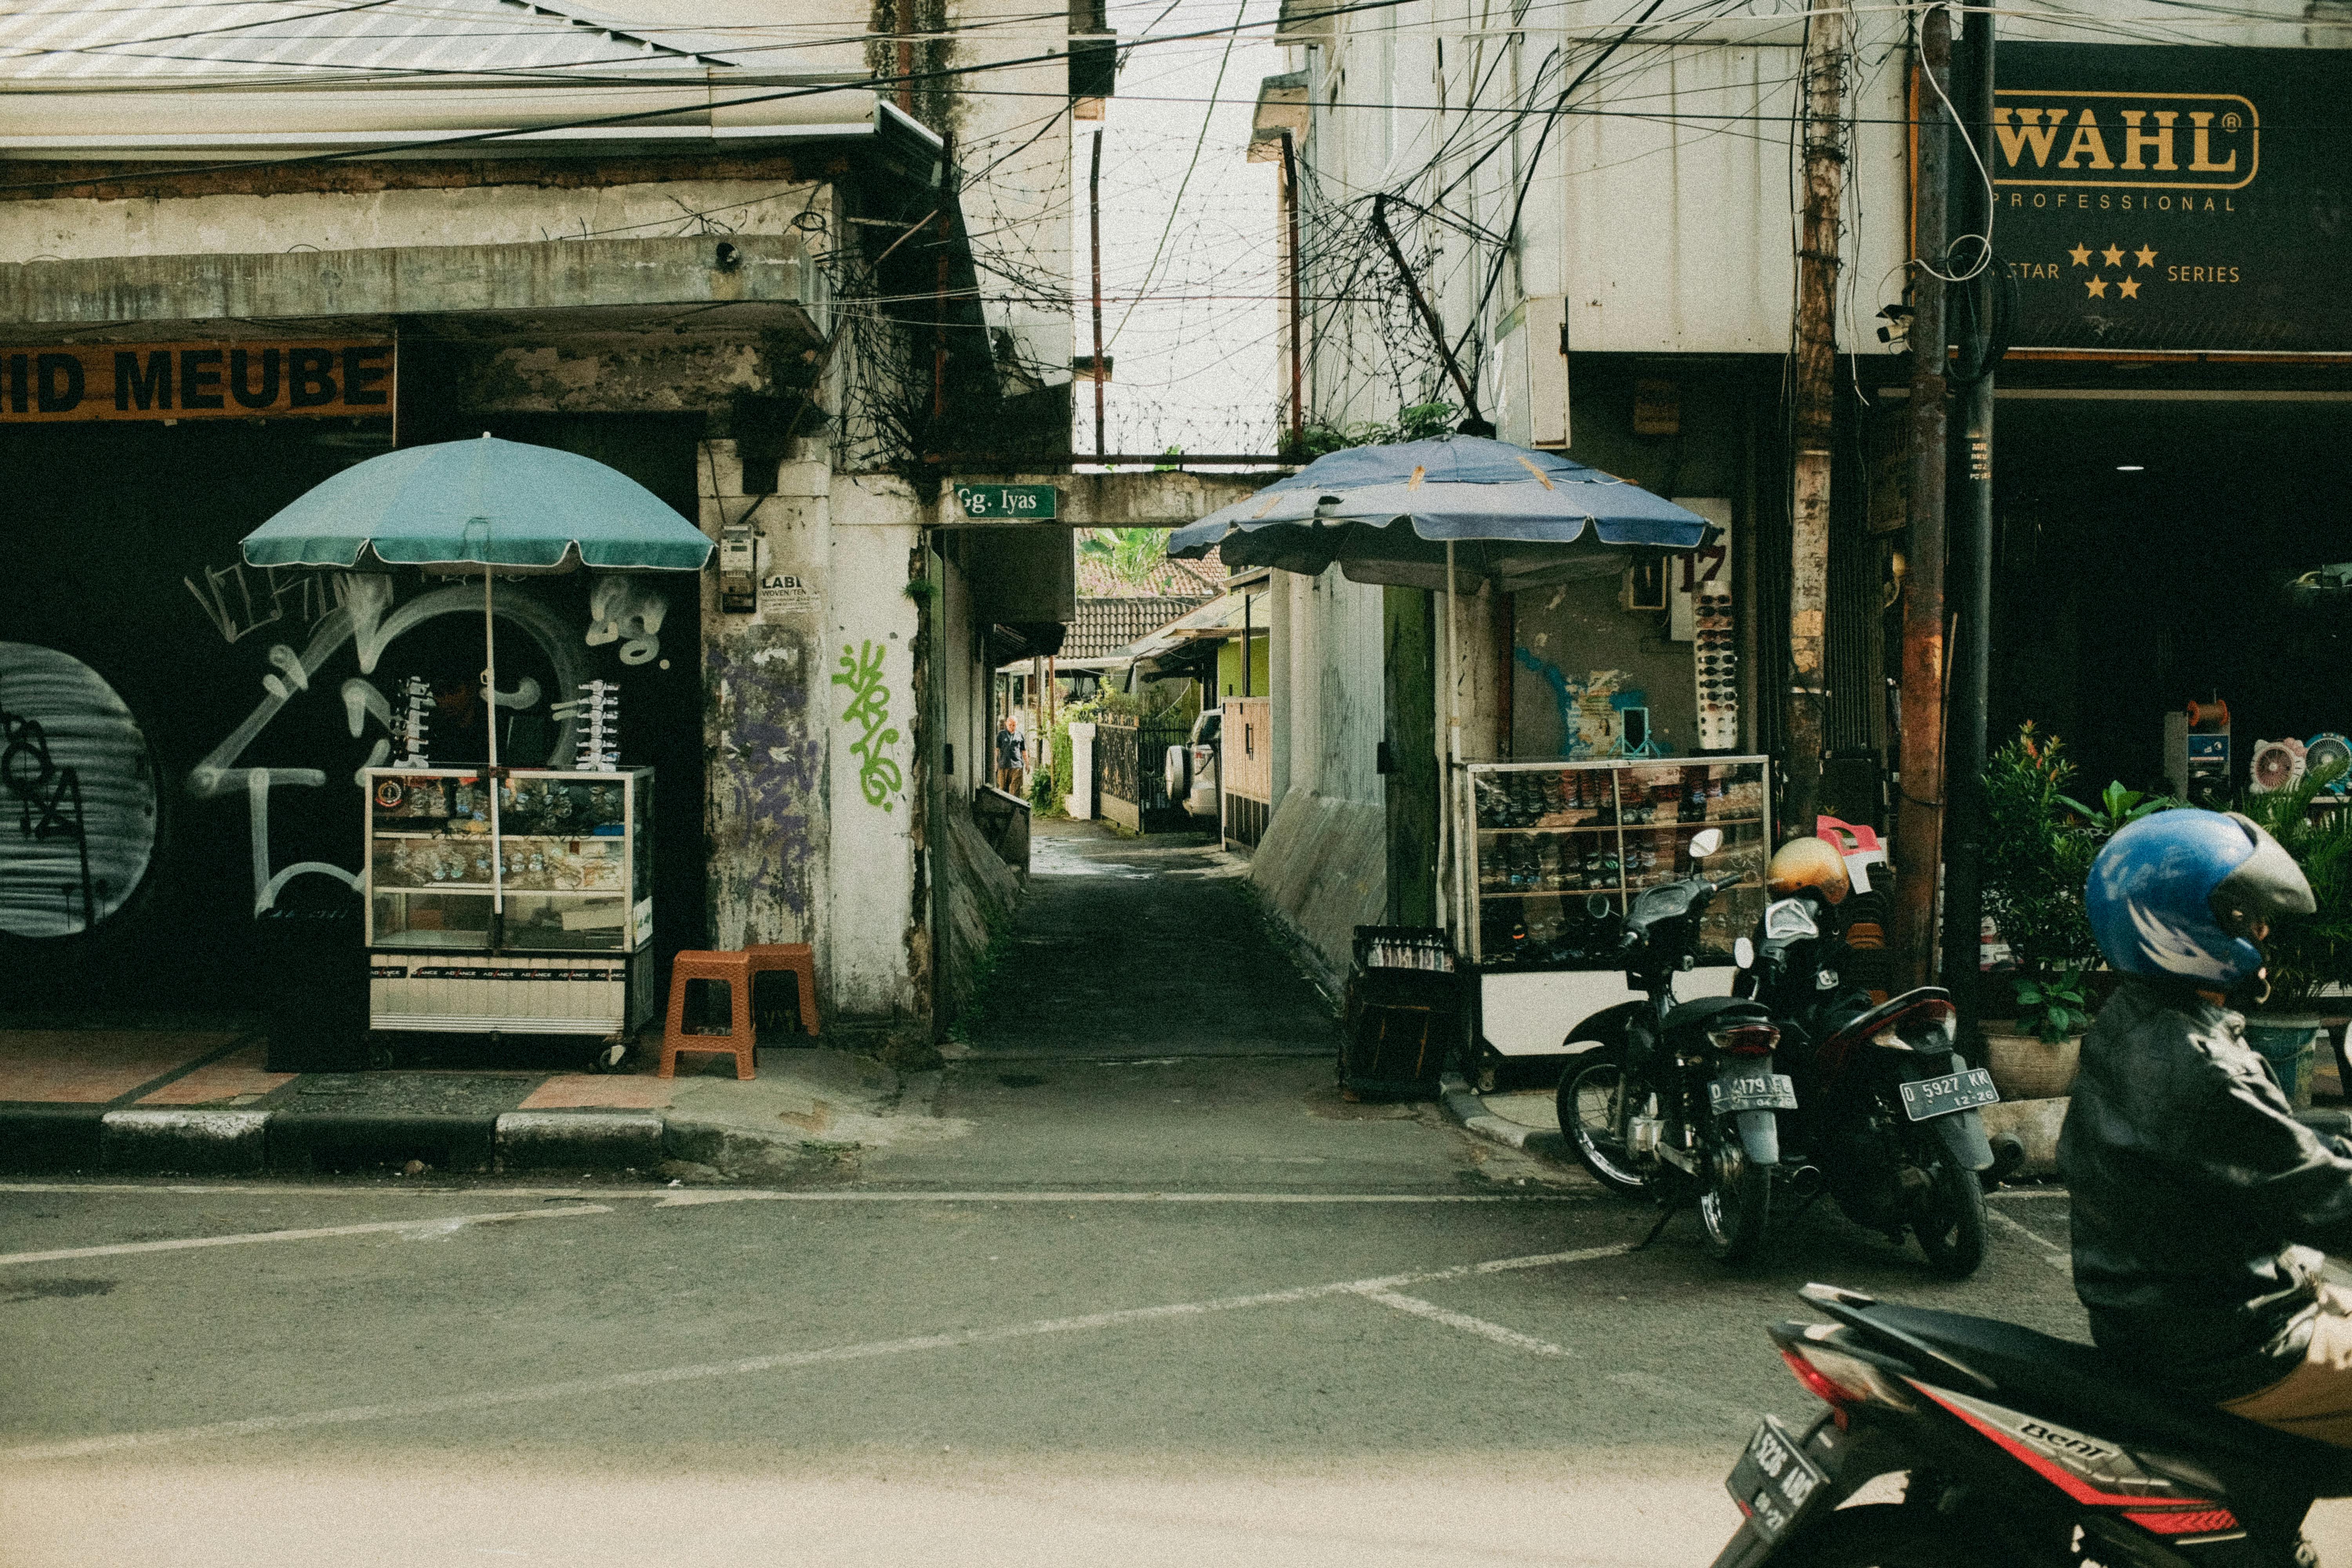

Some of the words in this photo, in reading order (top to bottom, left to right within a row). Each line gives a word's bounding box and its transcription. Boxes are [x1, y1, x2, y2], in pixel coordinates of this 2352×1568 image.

[2168, 266, 2240, 282] SERIES
[0, 353, 85, 413] ID
[114, 346, 387, 411] MEUBE
[1002, 490, 1036, 514] Iyas
[1678, 545, 1726, 592] 17
[1710, 1084, 1721, 1099] D
[1922, 1078, 1959, 1098] 5927
[1968, 1071, 1989, 1087] KK
